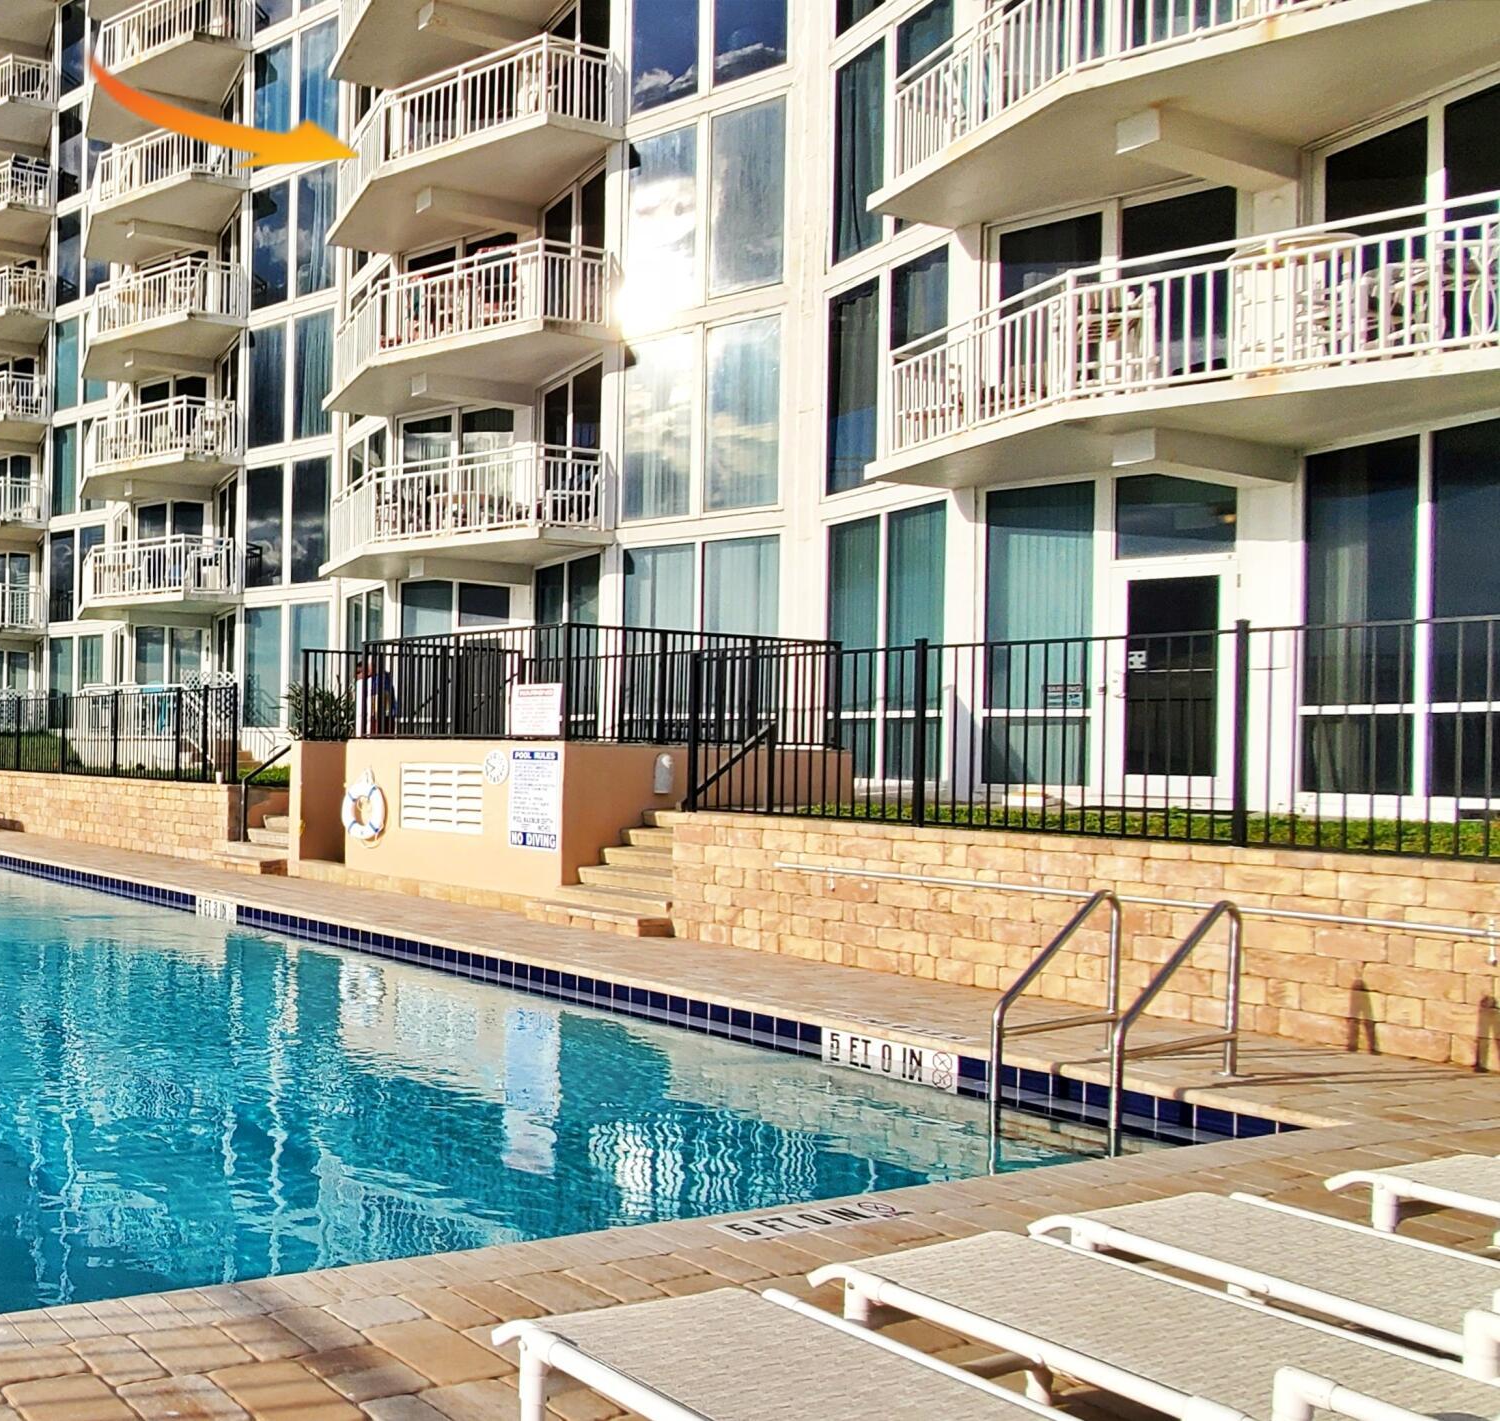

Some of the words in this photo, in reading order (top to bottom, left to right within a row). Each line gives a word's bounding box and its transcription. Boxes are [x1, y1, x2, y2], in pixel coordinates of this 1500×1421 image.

[515, 751, 531, 760] POOL
[534, 752, 555, 760] RULES
[511, 831, 523, 845] NO
[526, 832, 555, 849] DIVING
[831, 1032, 840, 1057] 5
[882, 1044, 892, 1070] 0
[902, 1047, 922, 1077] IN
[725, 1223, 761, 1236] 5
[797, 1213, 832, 1225] 0
